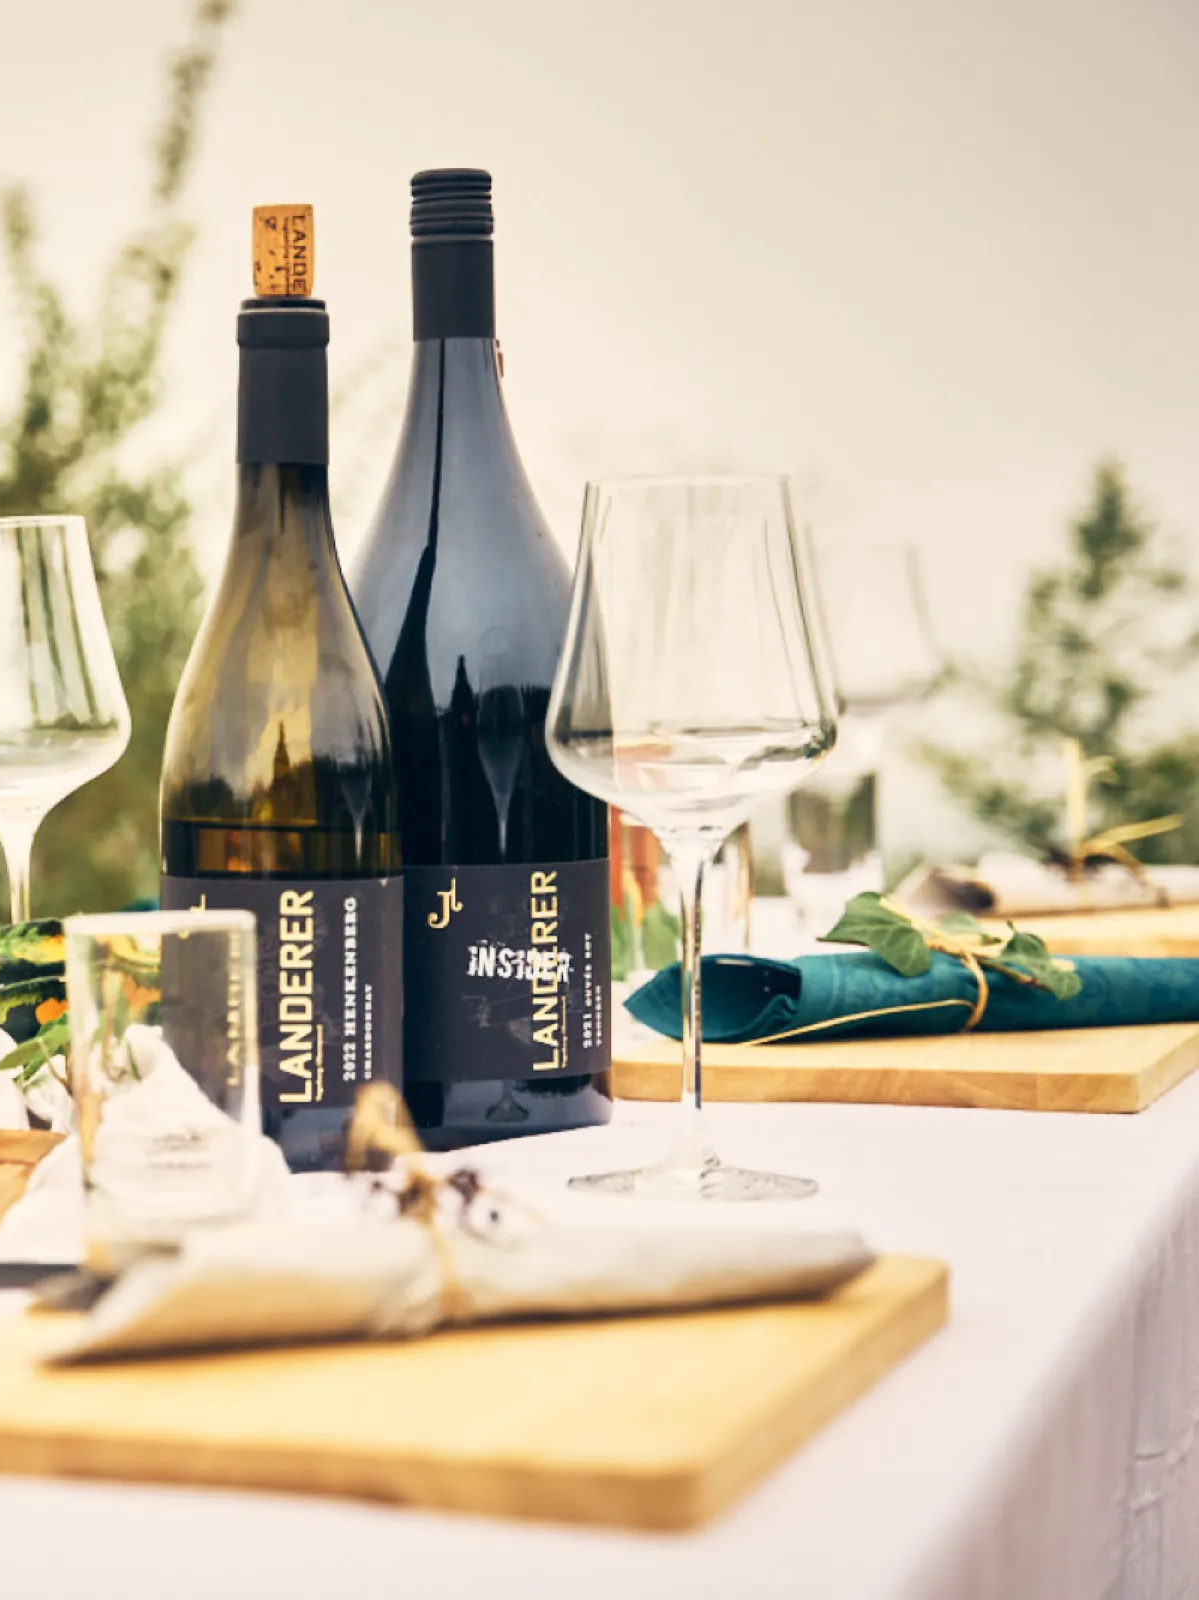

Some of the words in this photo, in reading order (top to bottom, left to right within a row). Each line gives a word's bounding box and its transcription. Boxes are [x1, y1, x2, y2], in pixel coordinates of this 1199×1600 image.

[279, 889, 314, 1103] LANDERER
[343, 896, 358, 1037] HENKENBERG
[531, 870, 558, 1072] LANDERER
[342, 1041, 357, 1082] 2022
